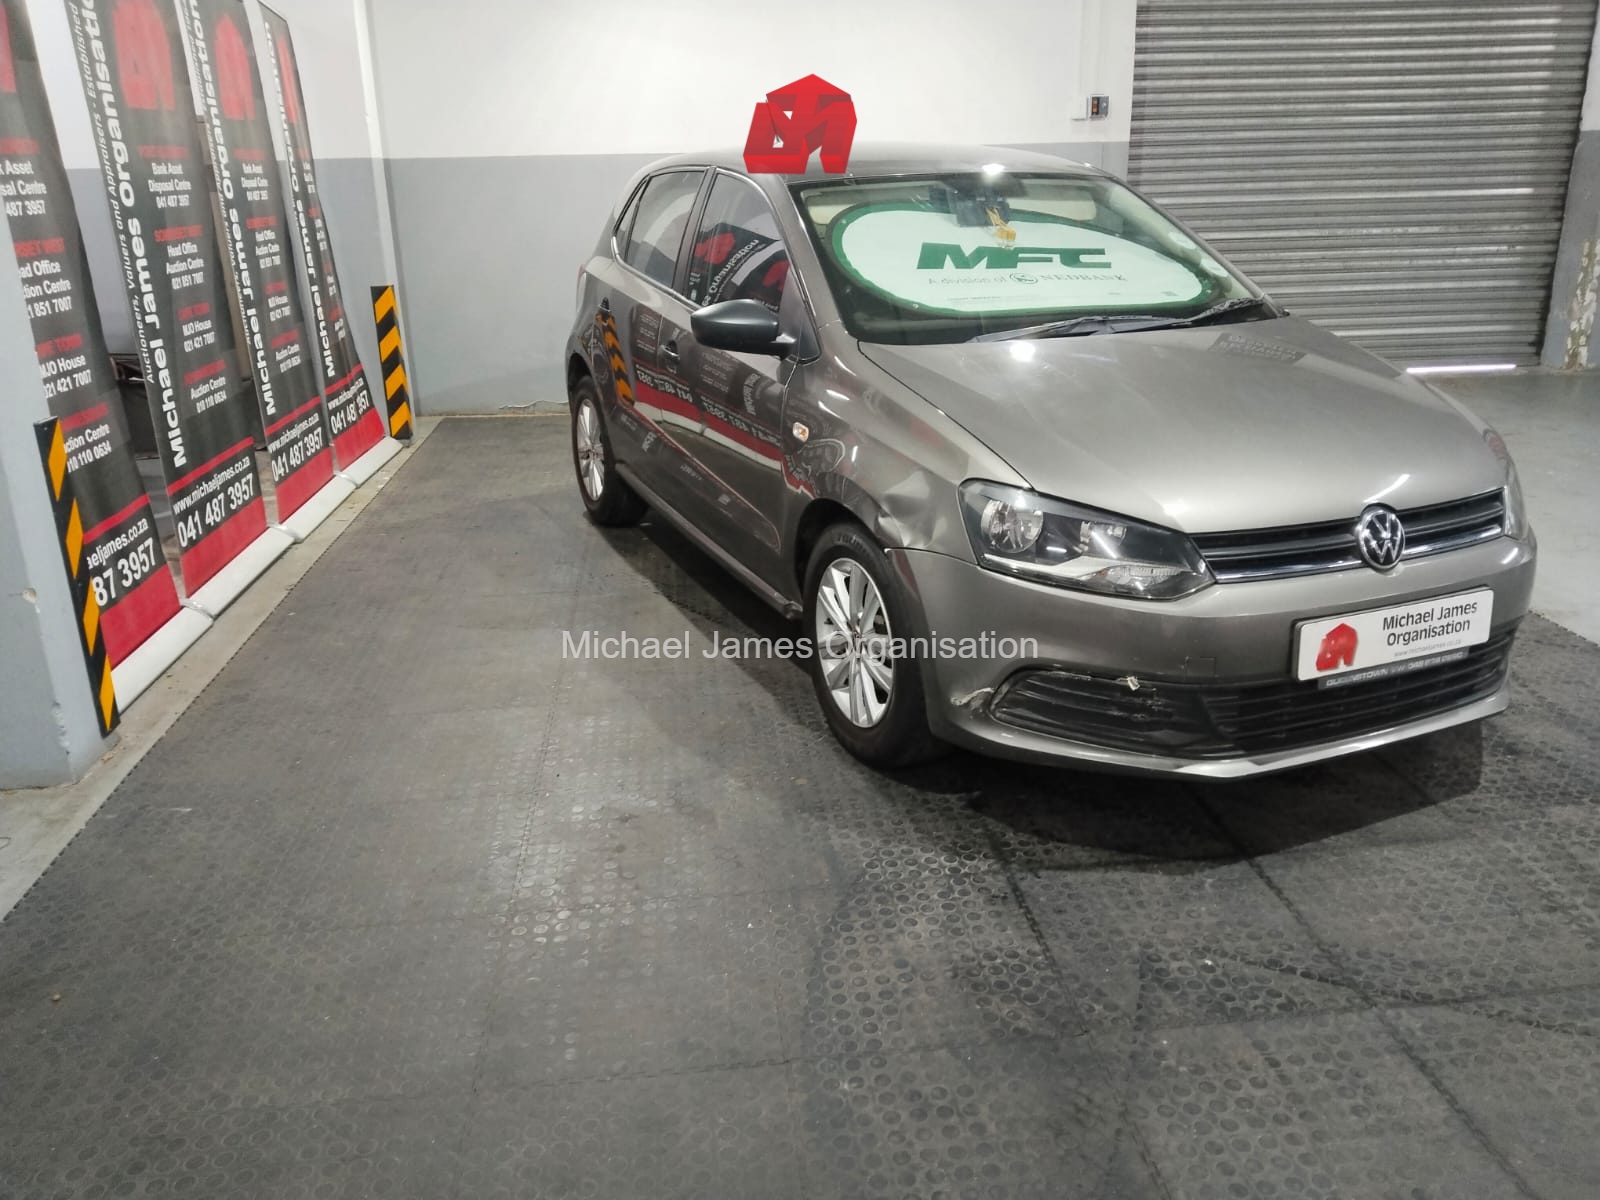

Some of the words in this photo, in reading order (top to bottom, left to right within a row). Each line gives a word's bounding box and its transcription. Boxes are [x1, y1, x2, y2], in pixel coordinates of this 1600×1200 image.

[5, 160, 34, 175] Asset
[17, 180, 47, 195] Centre
[6, 201, 23, 216] 487
[229, 207, 254, 300] James
[917, 242, 1112, 269] MFC
[33, 260, 61, 276] Office
[128, 217, 160, 330] James
[1039, 273, 1128, 285] NEDBANK
[43, 279, 72, 294] Centre
[33, 300, 52, 317] 851
[52, 296, 72, 313] 7007
[194, 320, 212, 332] House
[311, 285, 335, 377] Michael
[57, 355, 86, 373] House
[246, 307, 277, 416] Michael
[57, 376, 73, 393] 421
[73, 369, 93, 388] 7007
[150, 338, 187, 468] Michael
[85, 424, 110, 440] Centre
[330, 410, 347, 434] 041
[78, 449, 93, 467] 110
[271, 452, 289, 482] 041
[289, 441, 305, 468] 487
[304, 426, 323, 456] 3957
[173, 456, 250, 516] www.michaeljames.co.za
[177, 510, 202, 547] 041
[205, 492, 225, 526] 487
[227, 472, 253, 510] 3957
[93, 567, 117, 607] 87
[117, 537, 156, 588] 3957
[1382, 608, 1434, 631] Michael
[1437, 602, 1478, 621] James
[1387, 619, 1471, 646] Organisation
